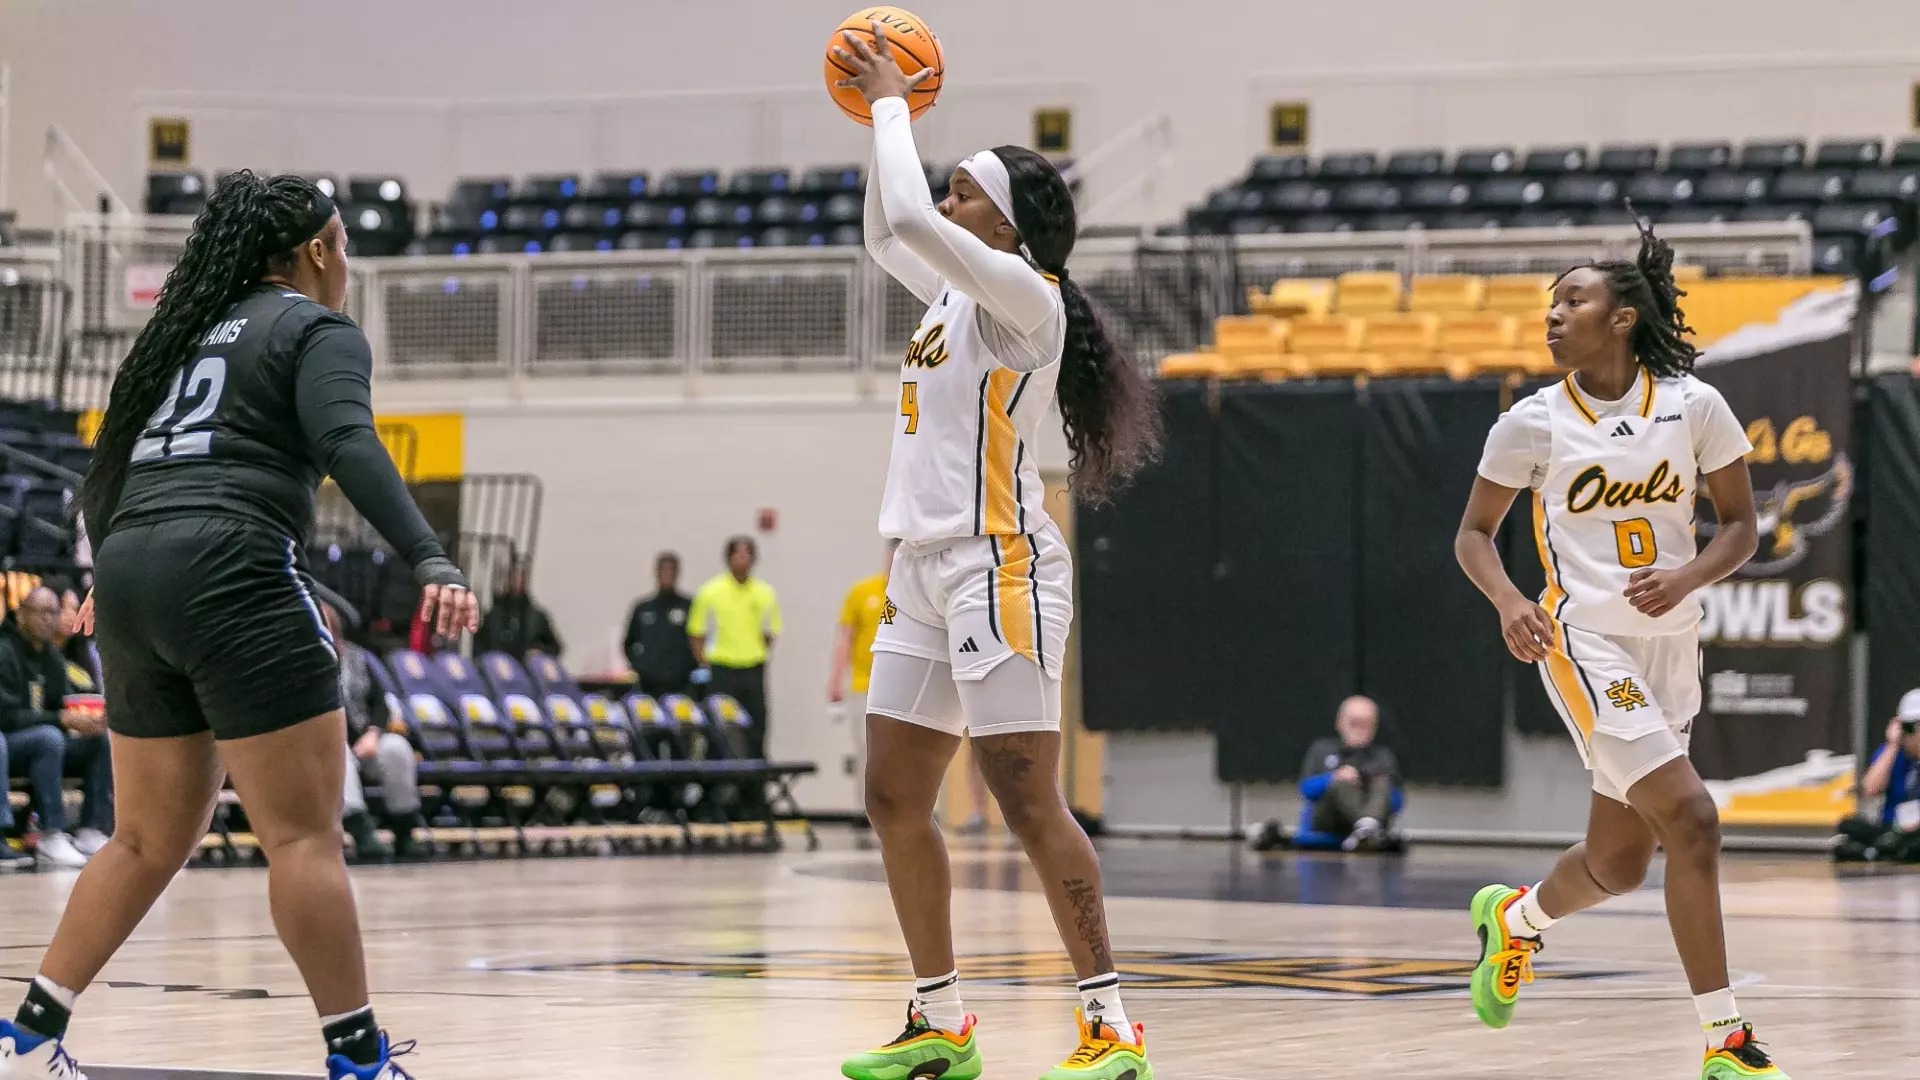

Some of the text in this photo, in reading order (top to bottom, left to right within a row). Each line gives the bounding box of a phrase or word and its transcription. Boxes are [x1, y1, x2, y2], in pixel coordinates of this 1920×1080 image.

[202, 318, 249, 346] AMS
[903, 322, 950, 370] wls
[1567, 458, 1685, 514] Owls
[1612, 516, 1658, 569] 0
[1699, 581, 1845, 642] OWLS
